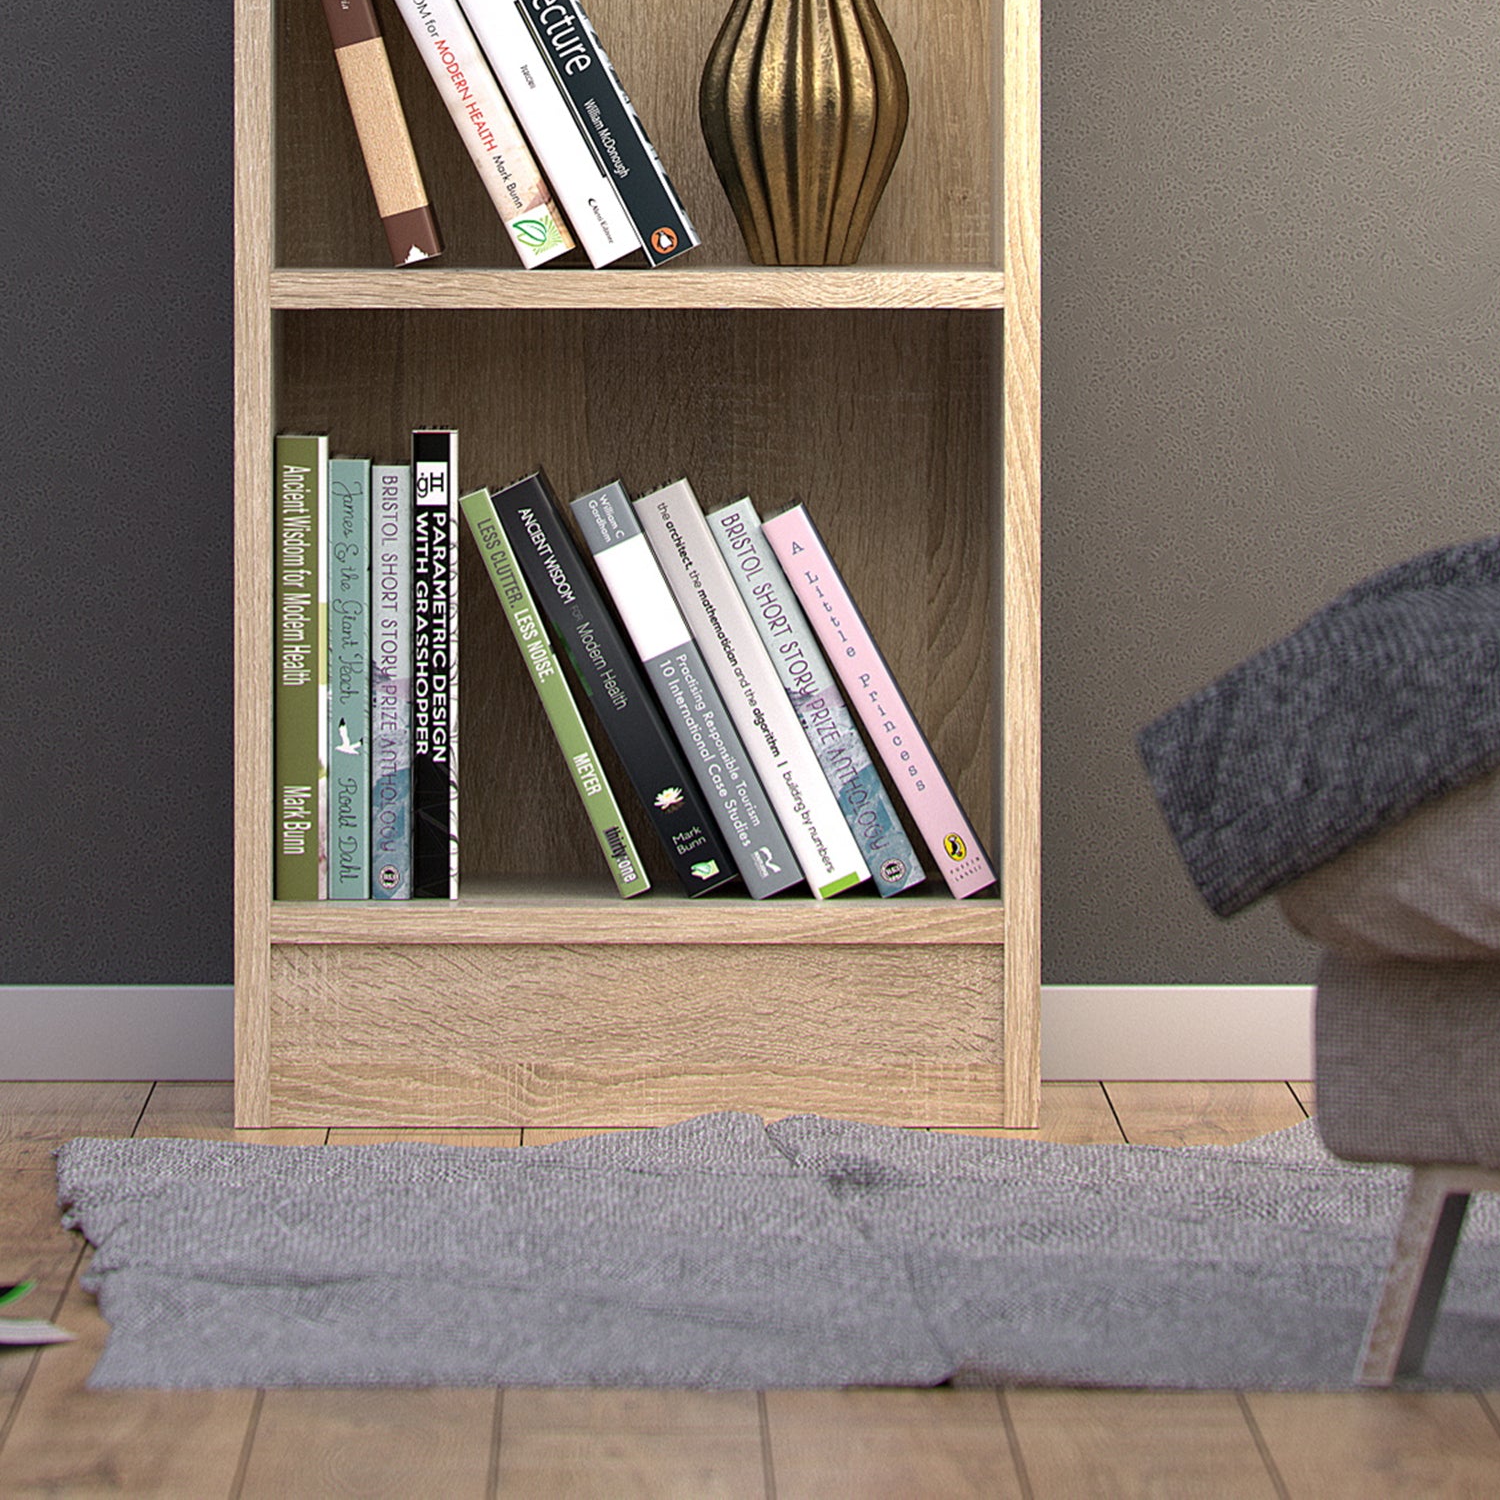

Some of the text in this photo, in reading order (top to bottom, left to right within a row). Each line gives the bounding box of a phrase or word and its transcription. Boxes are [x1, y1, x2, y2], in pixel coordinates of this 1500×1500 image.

[425, 19, 439, 37] for
[434, 39, 473, 101] MODERN
[466, 101, 497, 152] HEALTH
[493, 155, 512, 182] Mark
[506, 183, 524, 209] Bunn
[584, 98, 630, 179] William McDonough
[332, 481, 363, 538] James
[381, 475, 398, 546] BRISTOL
[588, 500, 612, 543] Gardham
[599, 494, 624, 538] William C
[282, 464, 312, 685] Ancient Wisdom for Modern Health
[341, 566, 359, 592] the
[380, 554, 398, 612] SHORT
[477, 518, 554, 683] LESS CLUTTER. LESS NOISE.
[518, 508, 552, 556] ANCIENT
[544, 556, 576, 605] WISDOM
[576, 622, 607, 670] Modern
[602, 669, 628, 710] Health
[333, 599, 362, 649] Giant
[380, 619, 398, 679] STORY
[415, 512, 429, 755] WITH GRASSHOPPER
[432, 512, 447, 762] PARAMETRIC DESIGN
[338, 652, 364, 705] Peach
[657, 502, 670, 522] the
[666, 520, 692, 570] architect,
[690, 570, 702, 588] the
[698, 589, 738, 666] mathematician
[734, 664, 750, 688] and
[744, 686, 758, 707] the
[753, 707, 780, 758] algorithm
[782, 770, 806, 812] building
[801, 810, 814, 826] by
[808, 825, 835, 873] numbers
[720, 512, 890, 851] BRISTOL SHORT STORY PRIZE ANTHOLOGY
[791, 540, 926, 792] A Little Princess
[380, 685, 398, 731] PRIZE
[676, 654, 706, 711] Practising
[703, 711, 739, 780] Responsible
[736, 782, 760, 827] Tourism
[574, 752, 602, 796] MEYER
[659, 660, 751, 847] 10 International Case Studies
[282, 785, 311, 855] Mark Bunn
[338, 777, 361, 883] Roald Dahl
[380, 739, 398, 852] ANTHOLOGY
[672, 826, 701, 844] Mark
[676, 834, 706, 855] Bunn
